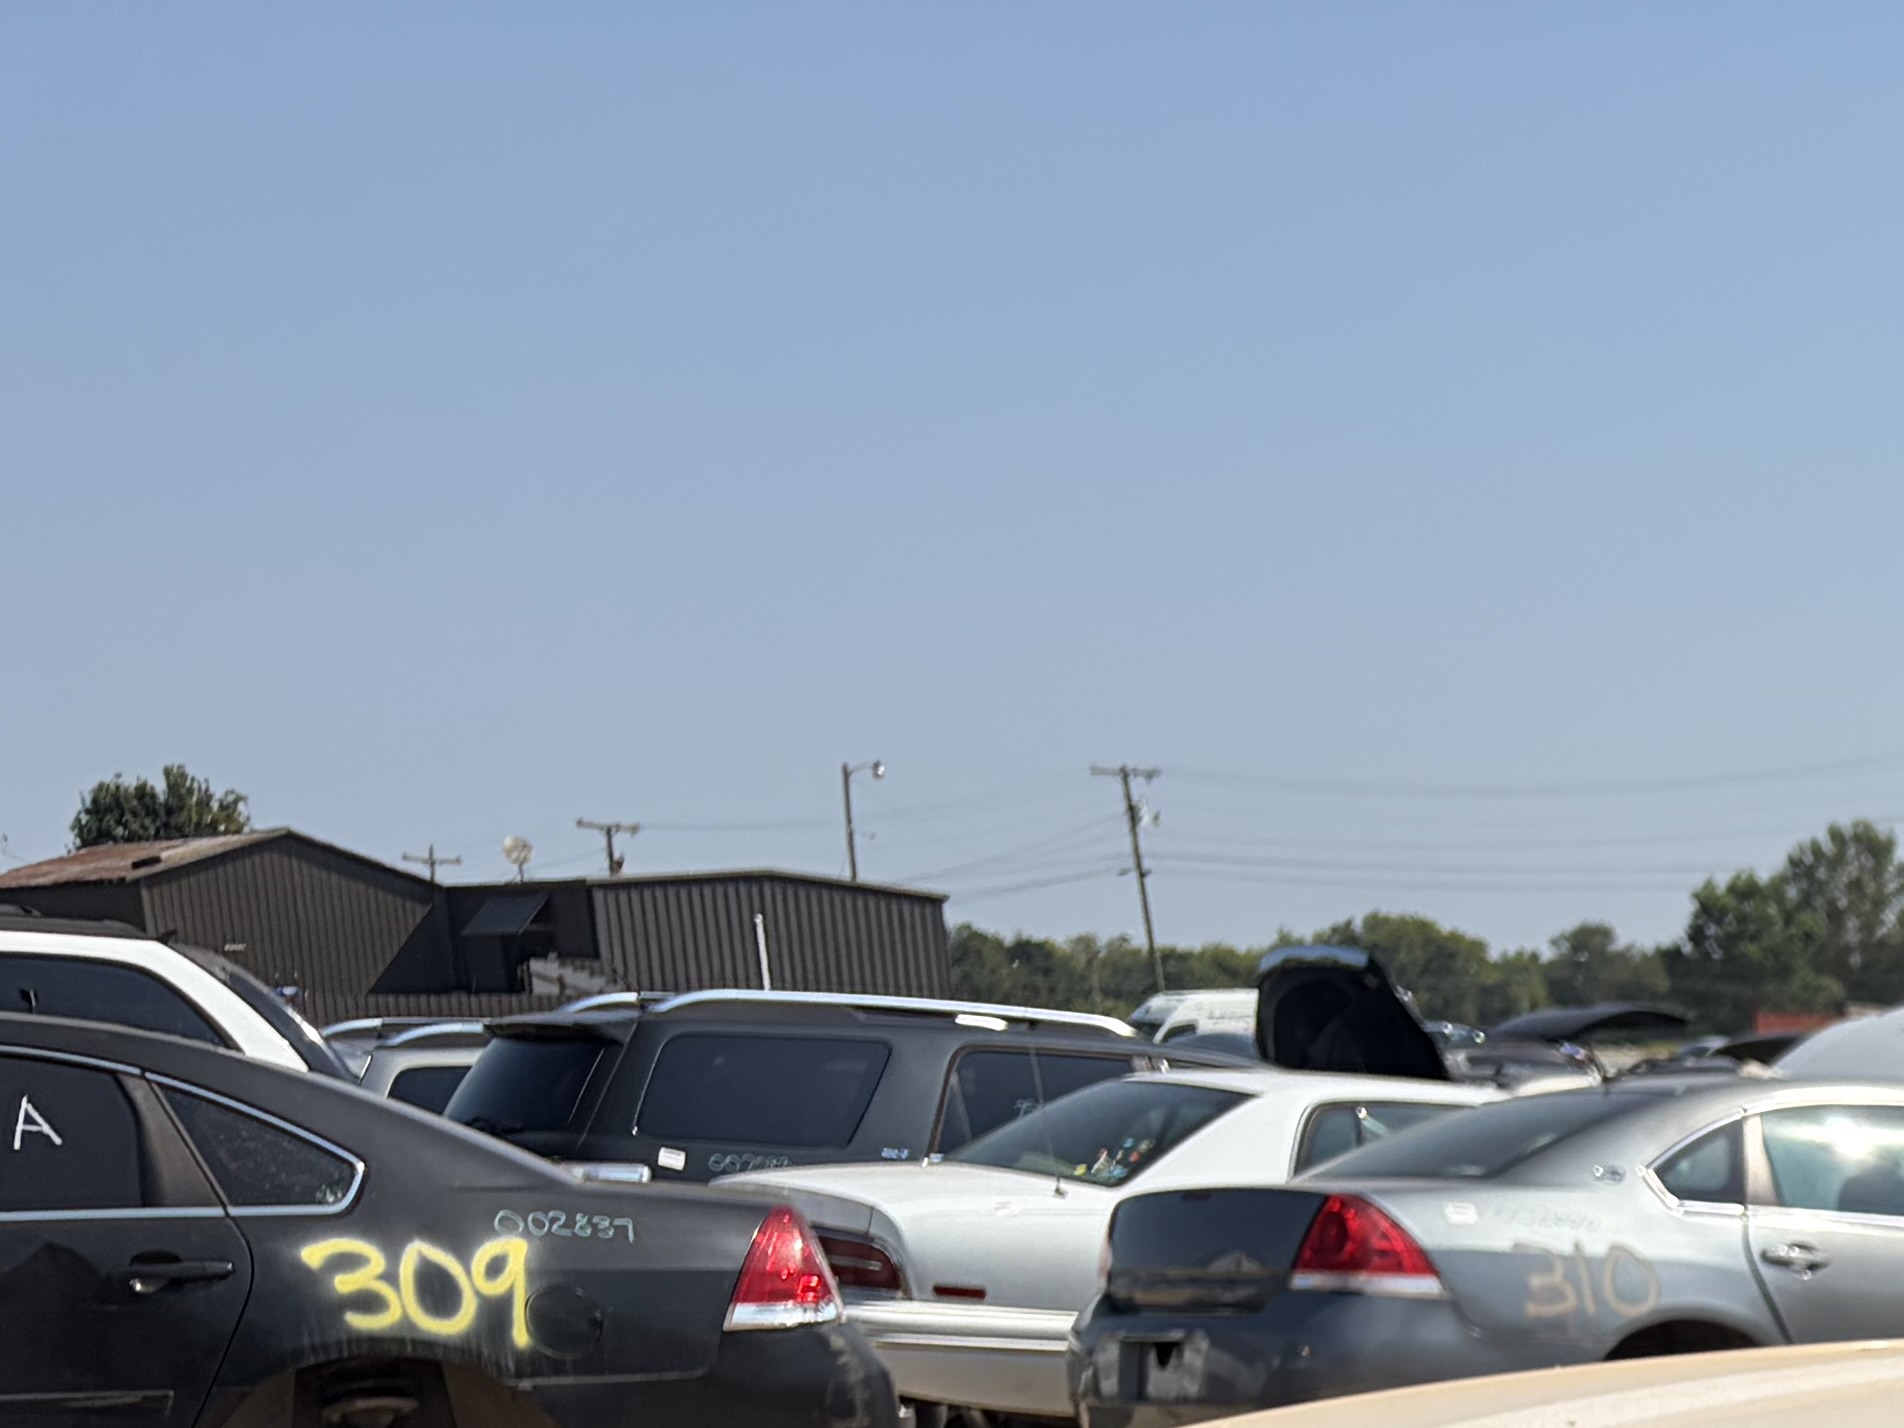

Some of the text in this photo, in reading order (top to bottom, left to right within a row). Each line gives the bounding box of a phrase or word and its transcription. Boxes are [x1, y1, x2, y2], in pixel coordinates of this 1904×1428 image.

[13, 1094, 63, 1151] A
[299, 1236, 530, 1348] 309
[1510, 1237, 1661, 1318] 310
